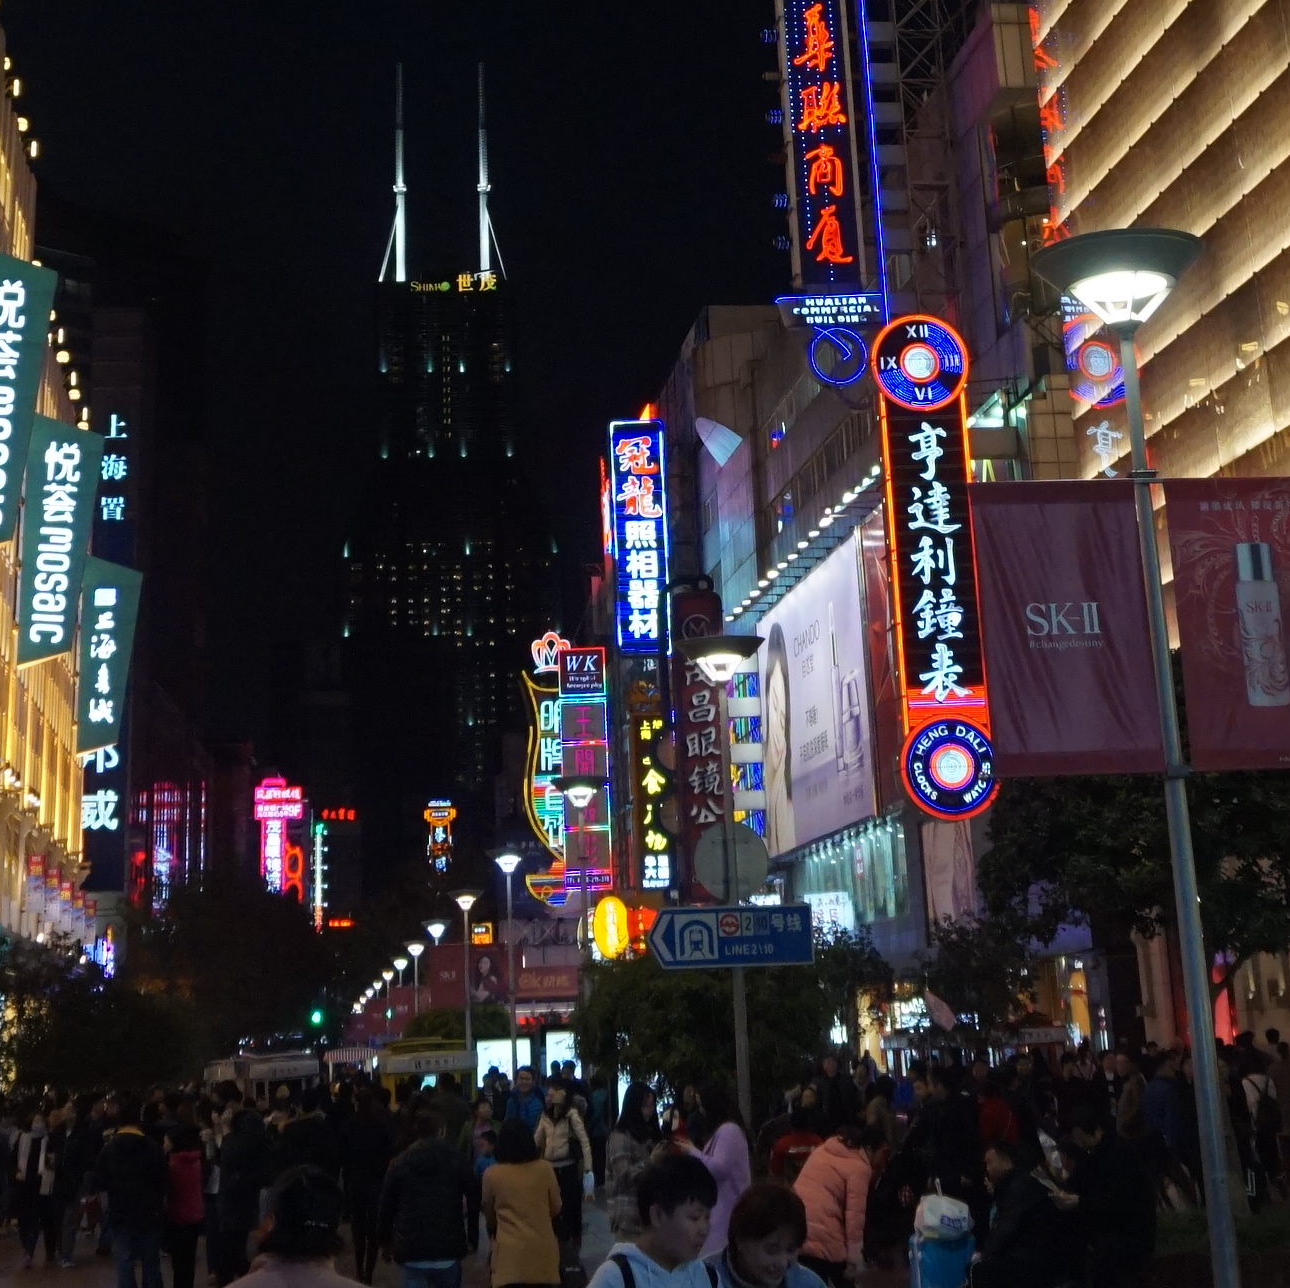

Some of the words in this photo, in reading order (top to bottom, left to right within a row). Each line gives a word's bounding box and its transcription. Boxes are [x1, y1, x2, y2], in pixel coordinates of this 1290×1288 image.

[793, 306, 880, 315] COMMERCIAL
[806, 297, 867, 306] HUALIAN
[615, 435, 663, 638] 冠龍照相器材
[907, 421, 974, 703] 亨達利鐘表
[1025, 602, 1102, 636] SK-II
[793, 620, 820, 658] CHANDO
[915, 726, 948, 755] HENG
[955, 726, 987, 753] DALI
[914, 762, 938, 800] CLOCKS
[963, 762, 990, 803] WATCES
[744, 917, 752, 931] 2
[771, 913, 803, 933] 号线
[725, 944, 750, 955] LINE
